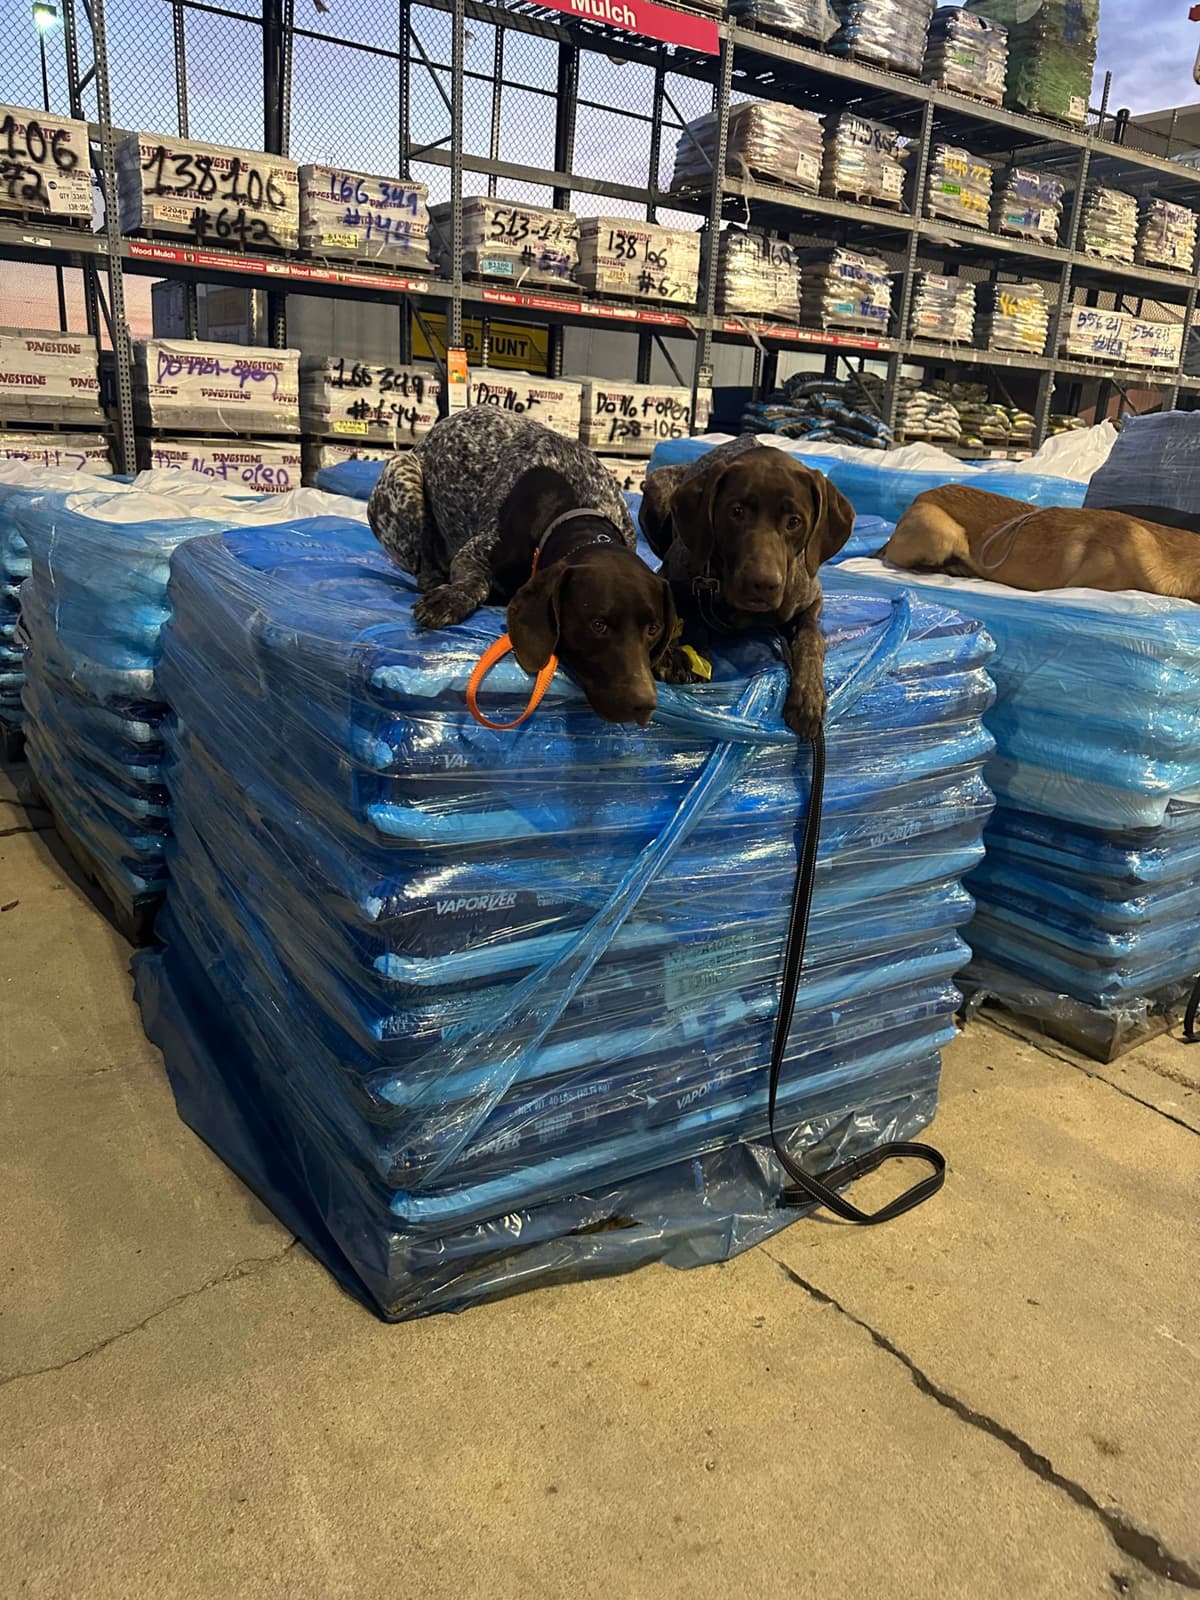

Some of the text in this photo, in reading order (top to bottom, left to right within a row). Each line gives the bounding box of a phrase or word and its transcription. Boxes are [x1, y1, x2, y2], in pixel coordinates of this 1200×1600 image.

[571, 0, 637, 28] Mulch
[130, 246, 176, 260] Wood Mulch
[608, 230, 638, 259] 138
[25, 341, 81, 355] PAVESTONE
